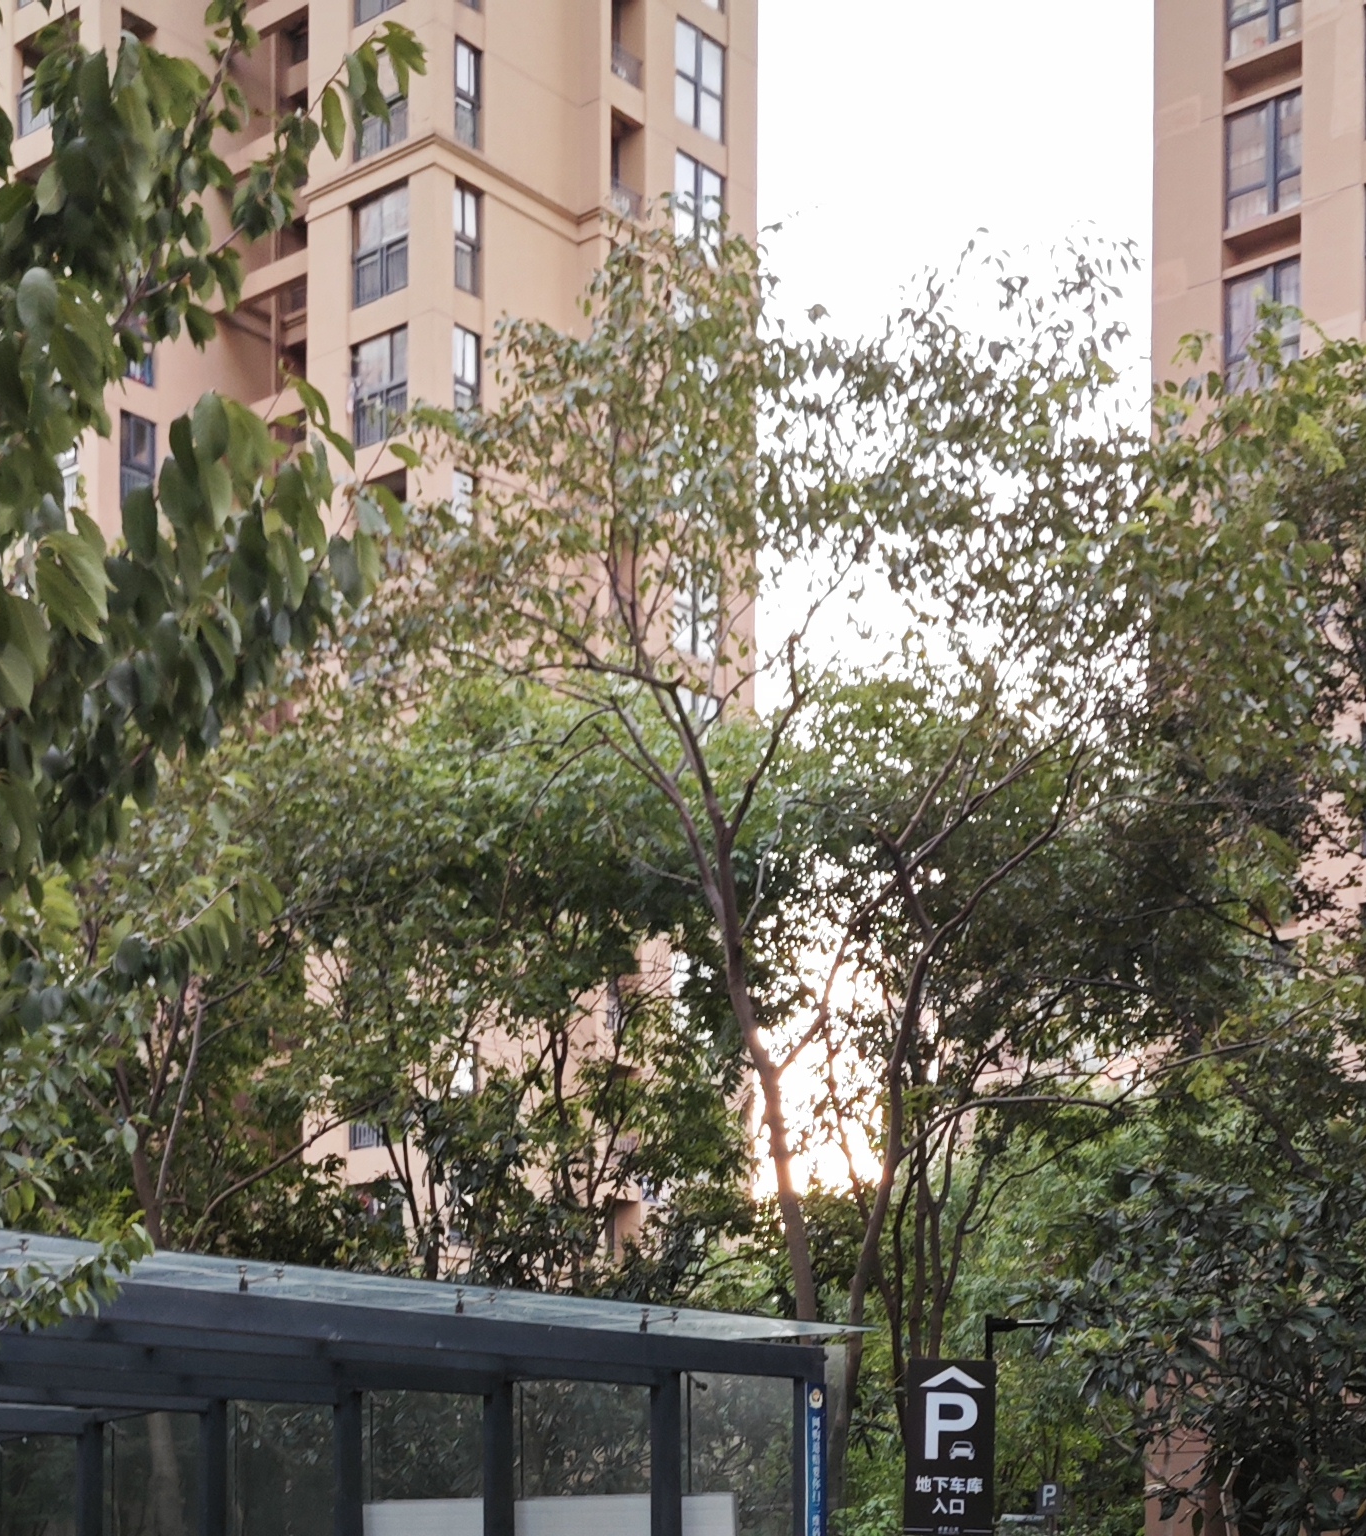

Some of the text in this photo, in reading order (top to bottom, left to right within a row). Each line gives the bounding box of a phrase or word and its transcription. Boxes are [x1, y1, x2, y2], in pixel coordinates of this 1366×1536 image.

[925, 1392, 978, 1460] P
[915, 1476, 984, 1495] 地下车库
[1042, 1484, 1057, 1507] P
[931, 1498, 965, 1515] 入口
